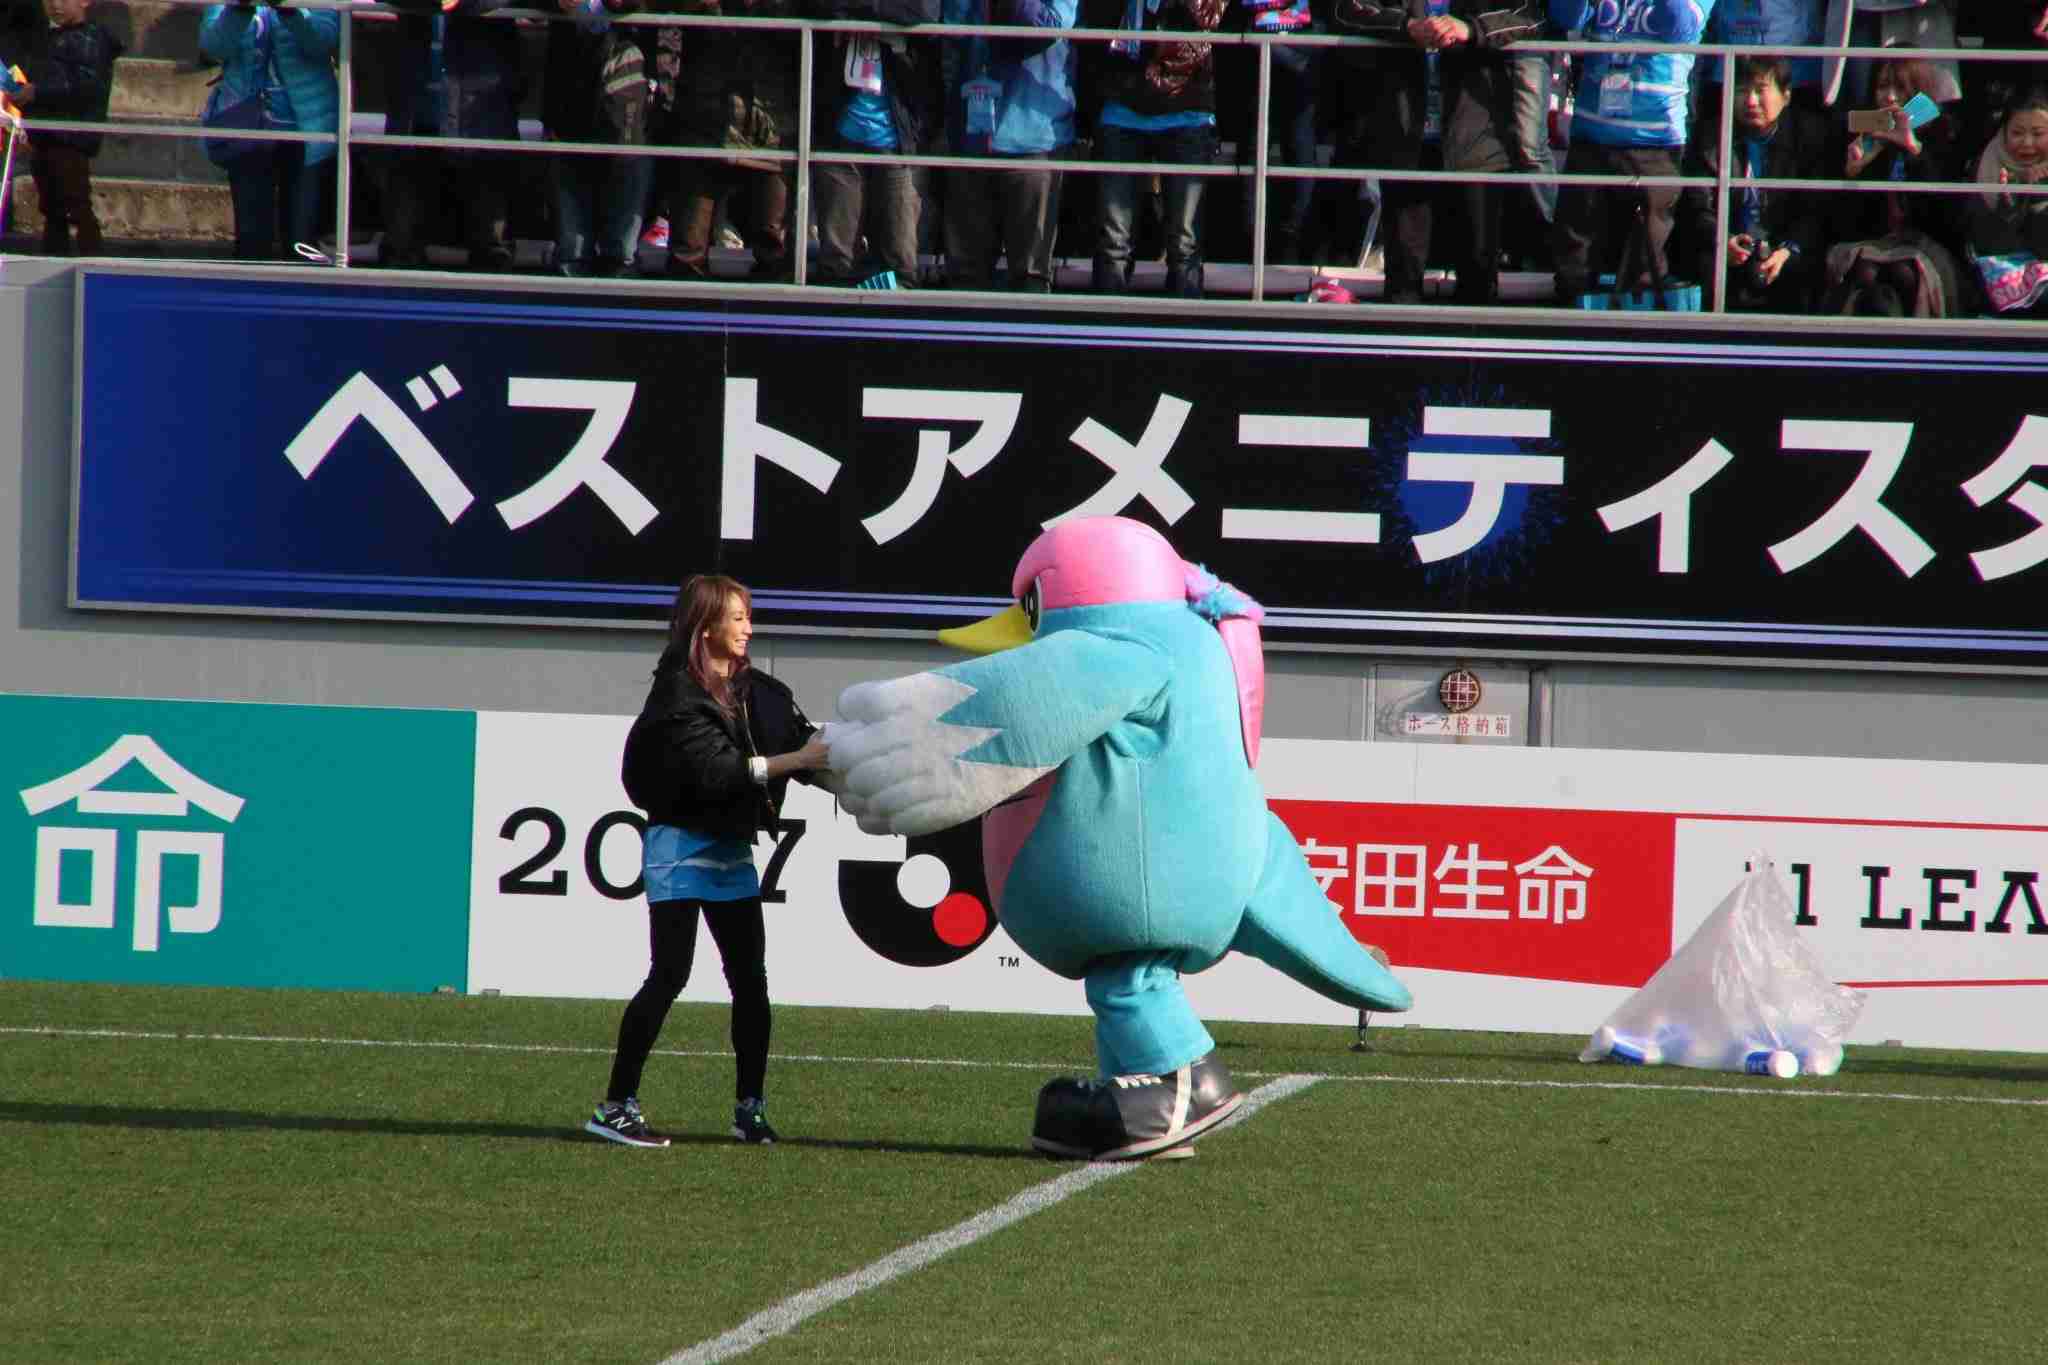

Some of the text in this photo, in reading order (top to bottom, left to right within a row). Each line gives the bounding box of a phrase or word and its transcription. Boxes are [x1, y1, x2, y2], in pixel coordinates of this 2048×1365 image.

[21, 735, 245, 951] 命
[499, 806, 806, 903] 207
[998, 956, 1020, 967] TM
